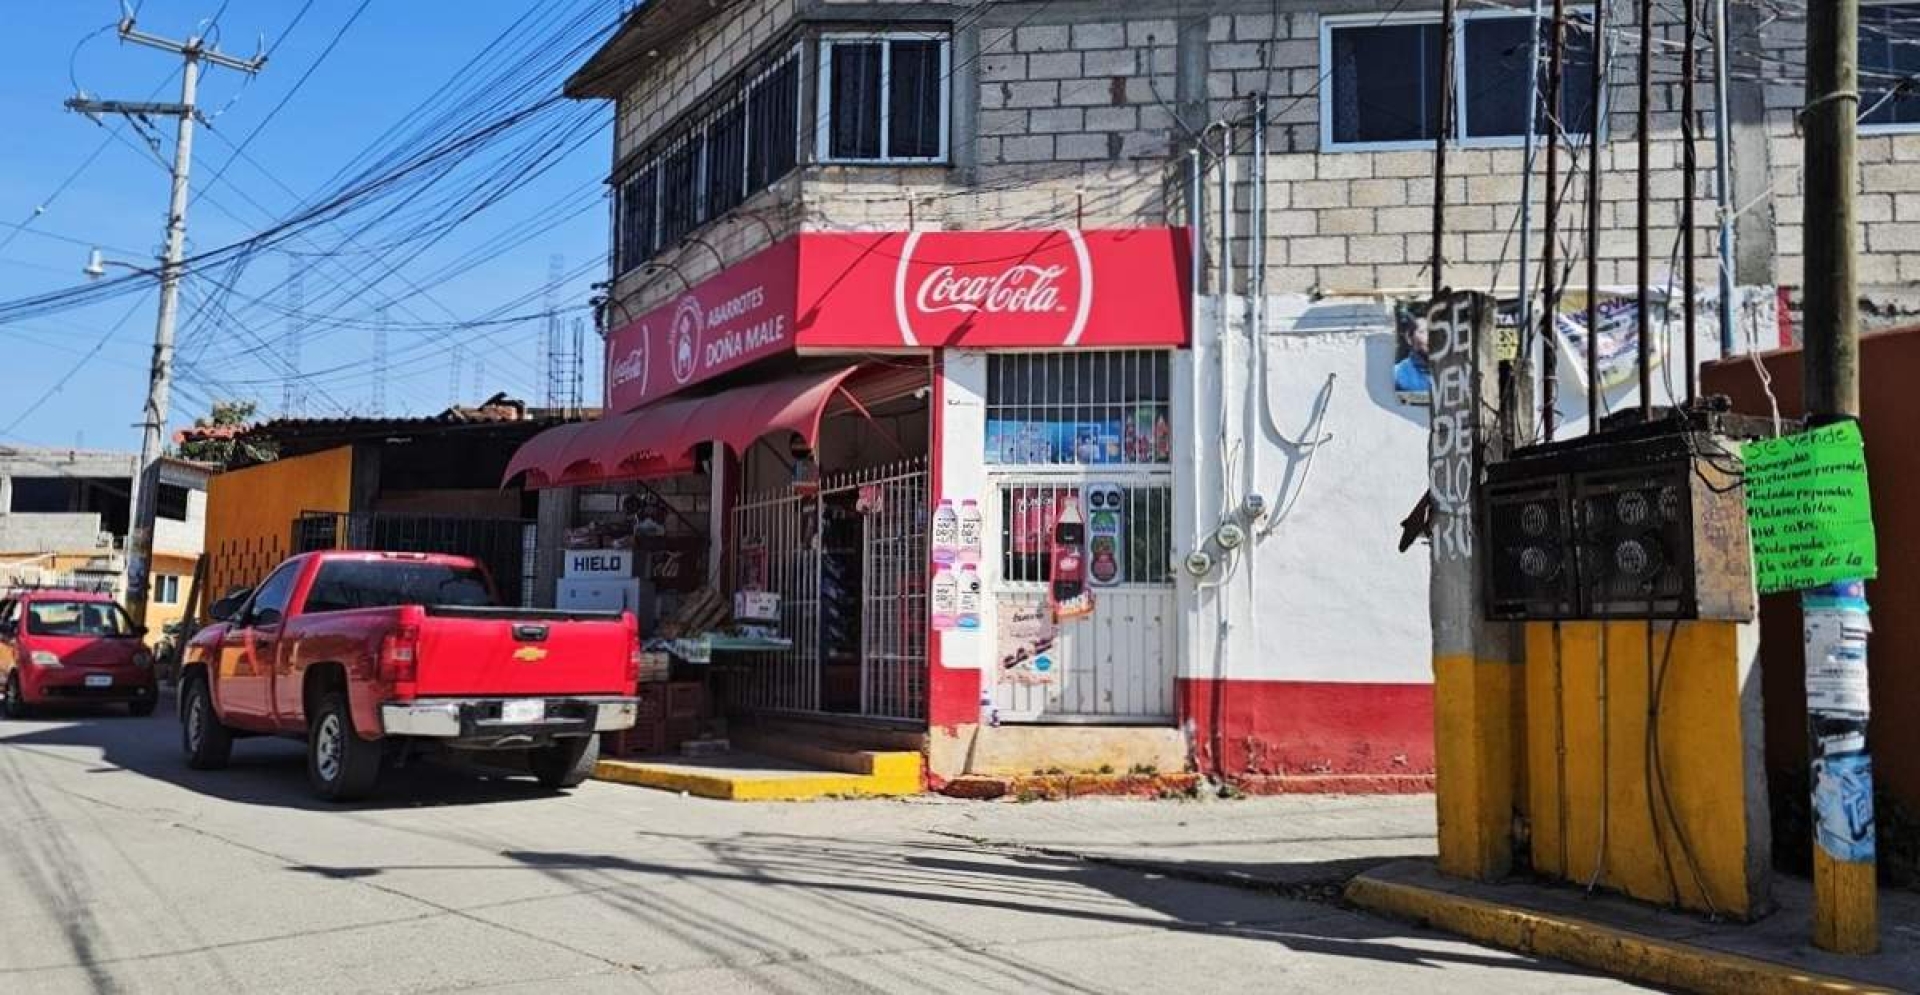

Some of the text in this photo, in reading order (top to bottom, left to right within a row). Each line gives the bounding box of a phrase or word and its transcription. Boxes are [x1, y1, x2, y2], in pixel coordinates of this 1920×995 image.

[707, 286, 764, 328] ABARROTES
[916, 264, 1069, 313] Coca-Cola
[705, 332, 743, 368] DOÑA
[745, 315, 785, 350] MALE
[573, 556, 622, 572] HIELO
[1846, 551, 1863, 567] la
